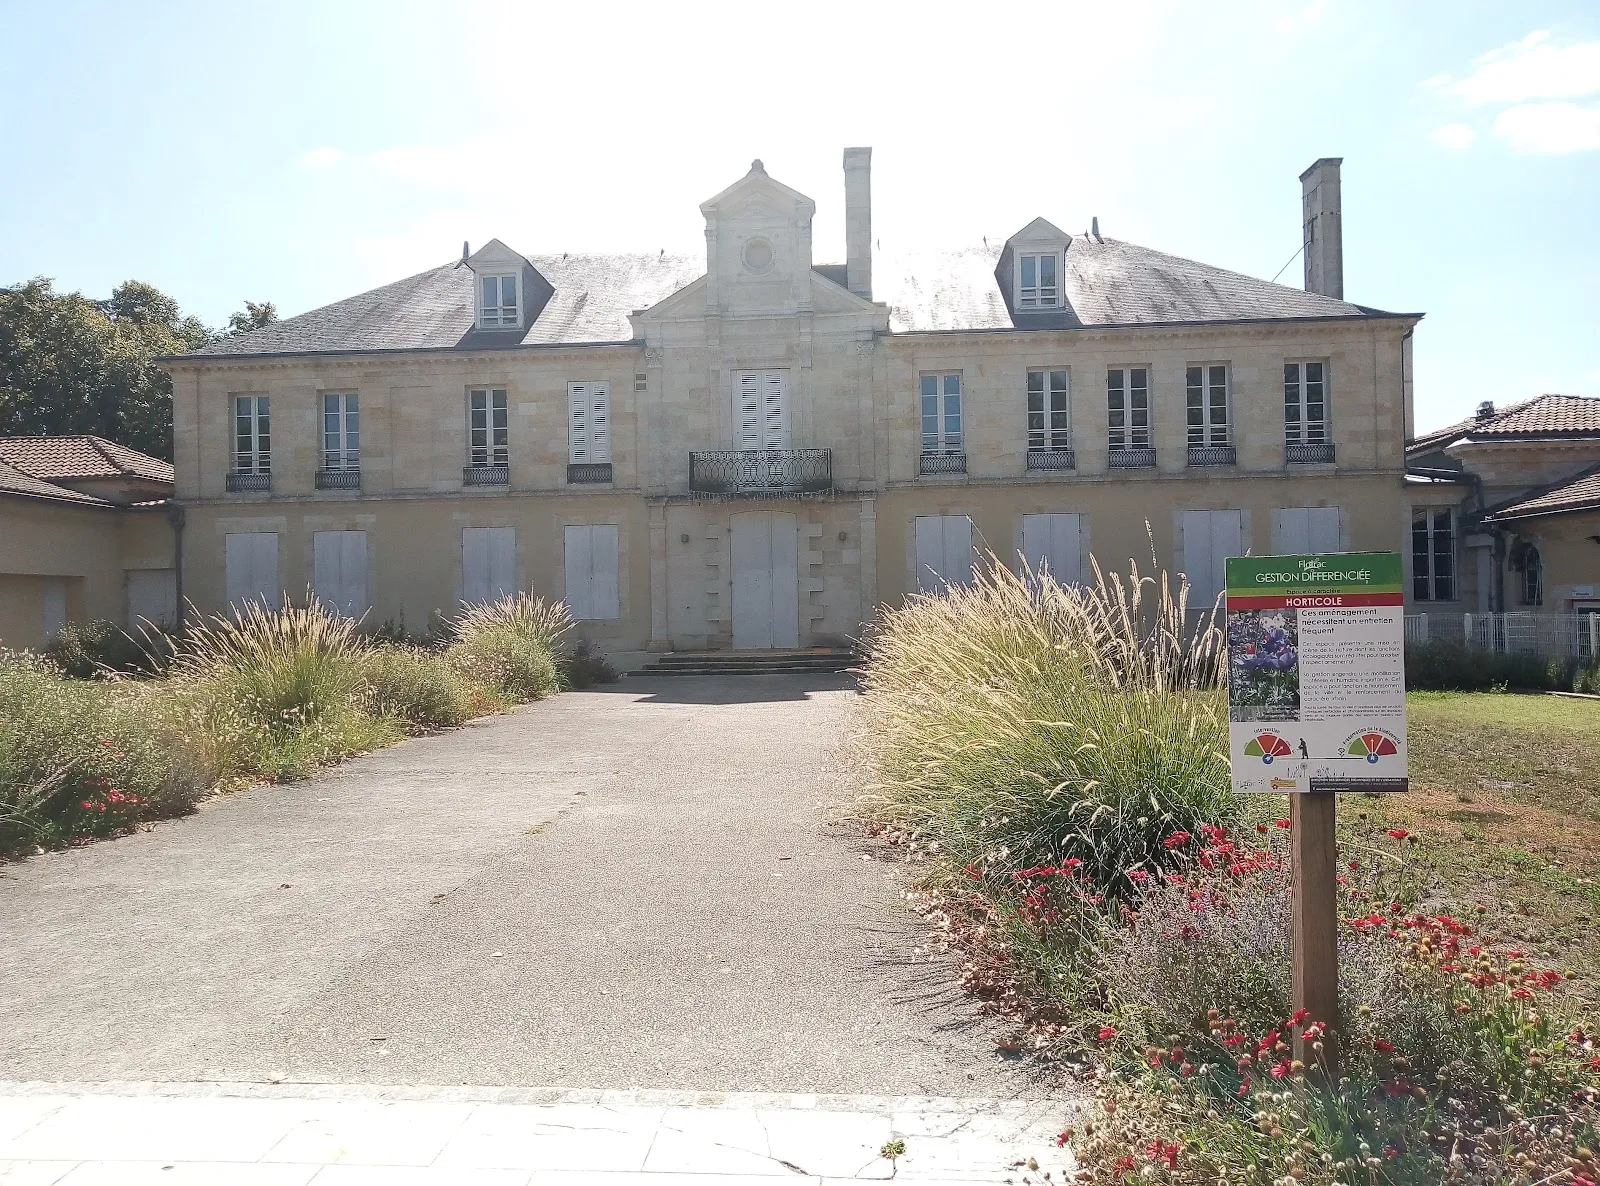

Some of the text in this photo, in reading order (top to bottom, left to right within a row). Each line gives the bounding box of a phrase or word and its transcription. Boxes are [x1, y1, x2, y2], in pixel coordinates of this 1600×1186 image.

[1256, 568, 1370, 582] GESTION DIFFERENCIÉE
[1286, 597, 1342, 606] HORTICOLE
